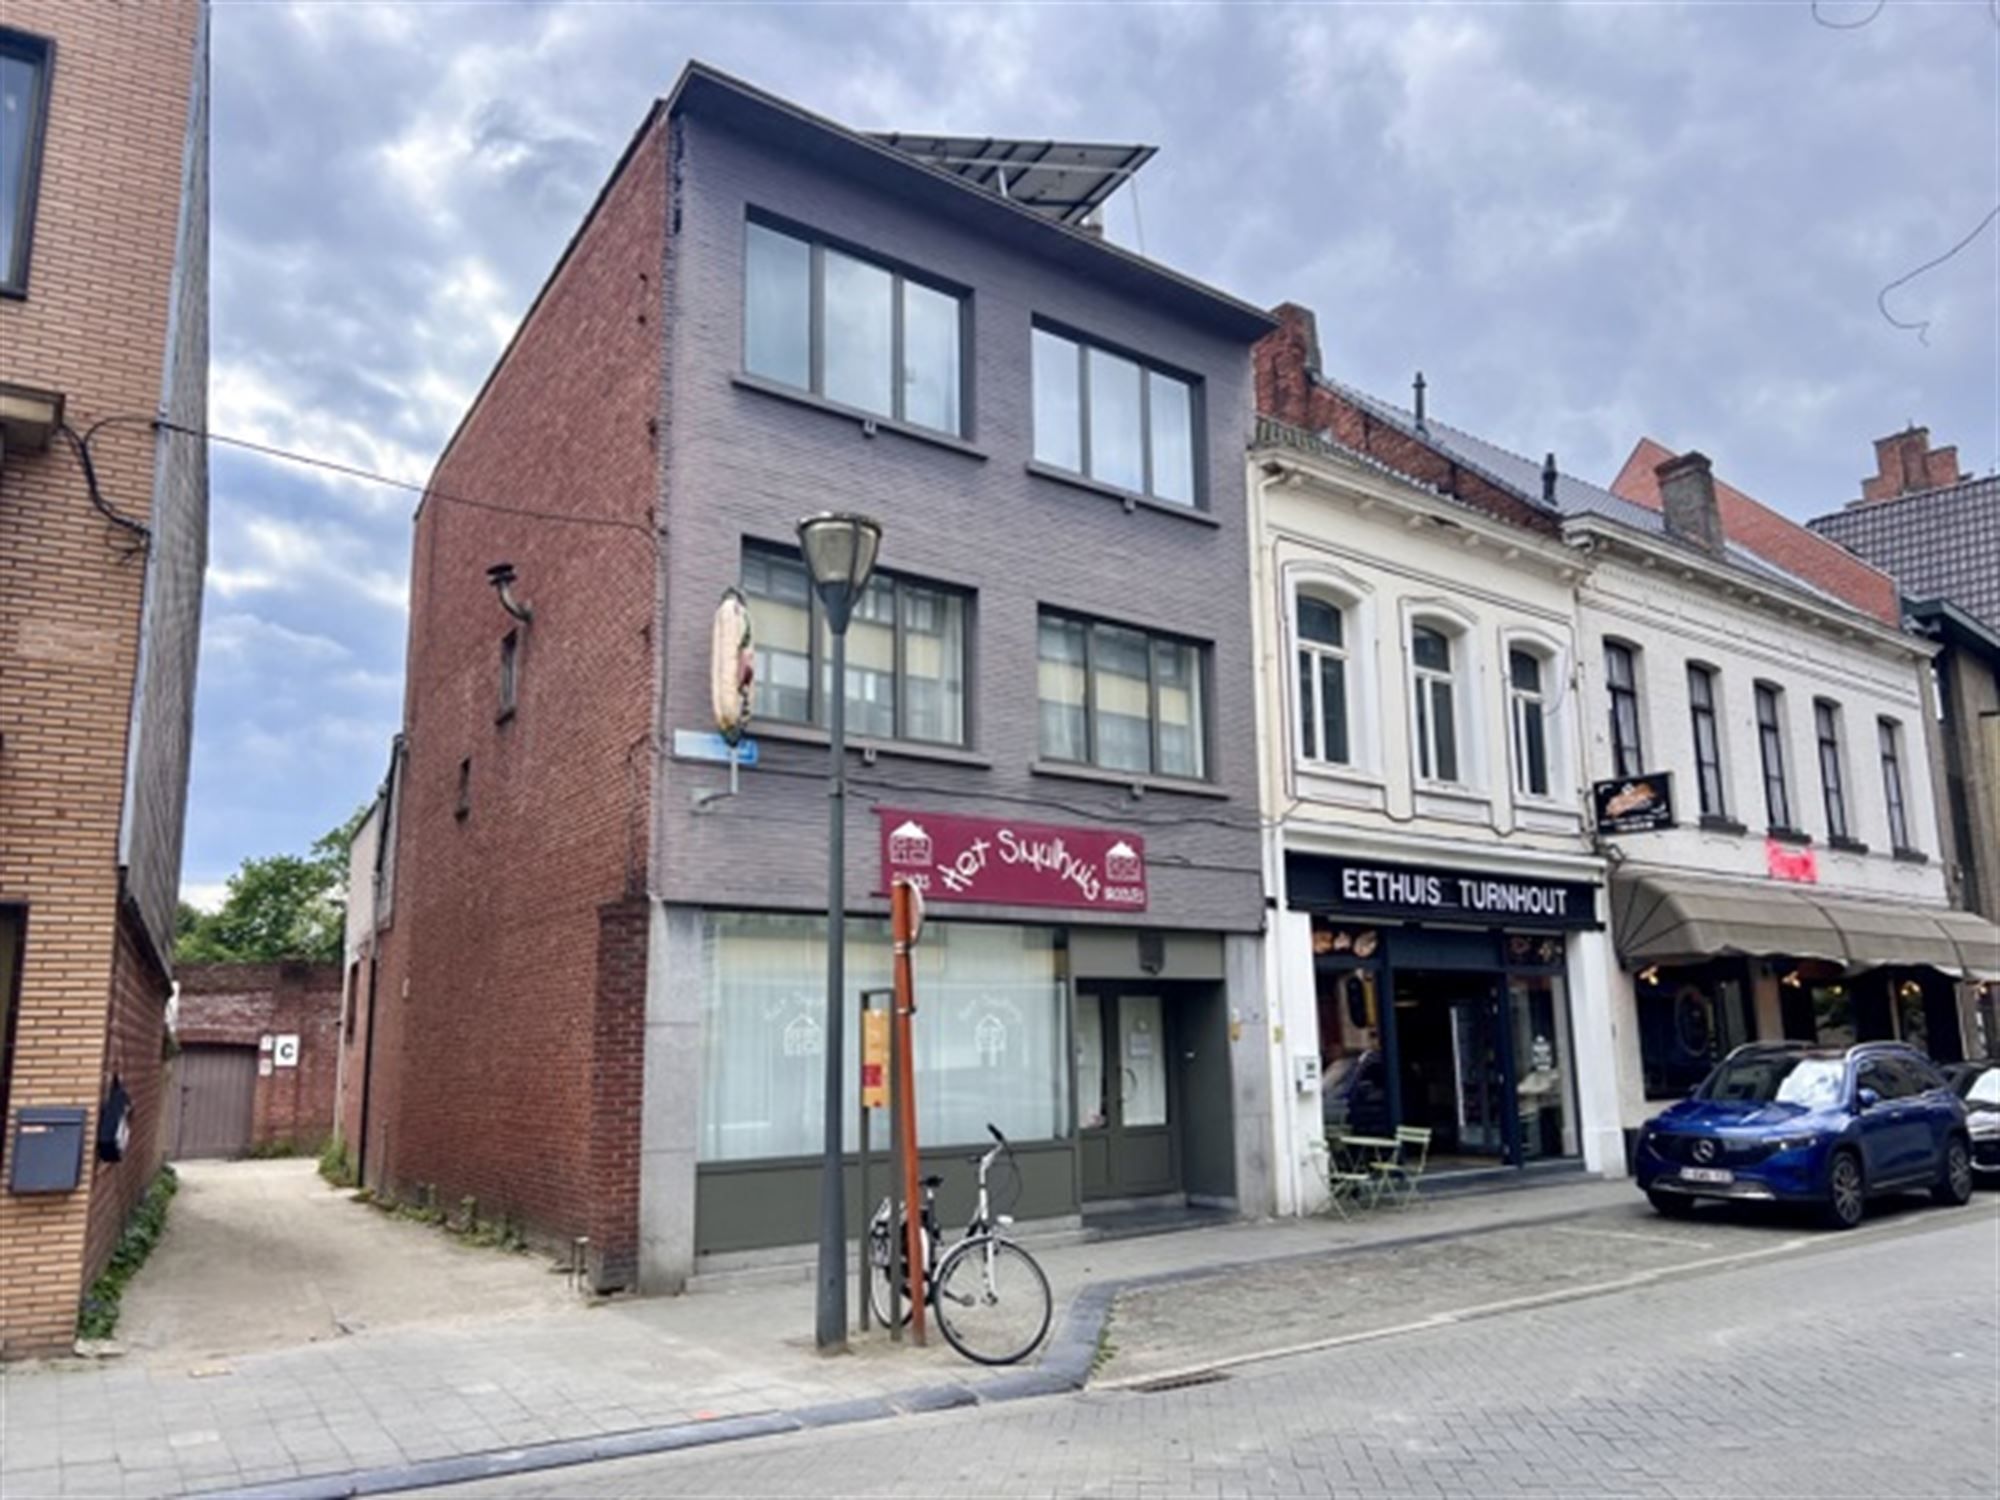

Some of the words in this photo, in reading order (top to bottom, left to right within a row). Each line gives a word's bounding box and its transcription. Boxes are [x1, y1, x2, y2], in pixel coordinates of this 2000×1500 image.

[937, 837, 991, 892] Het
[1342, 868, 1441, 905] EETHUIS
[1458, 879, 1567, 915] TURNHOUT
[280, 1042, 294, 1060] C
